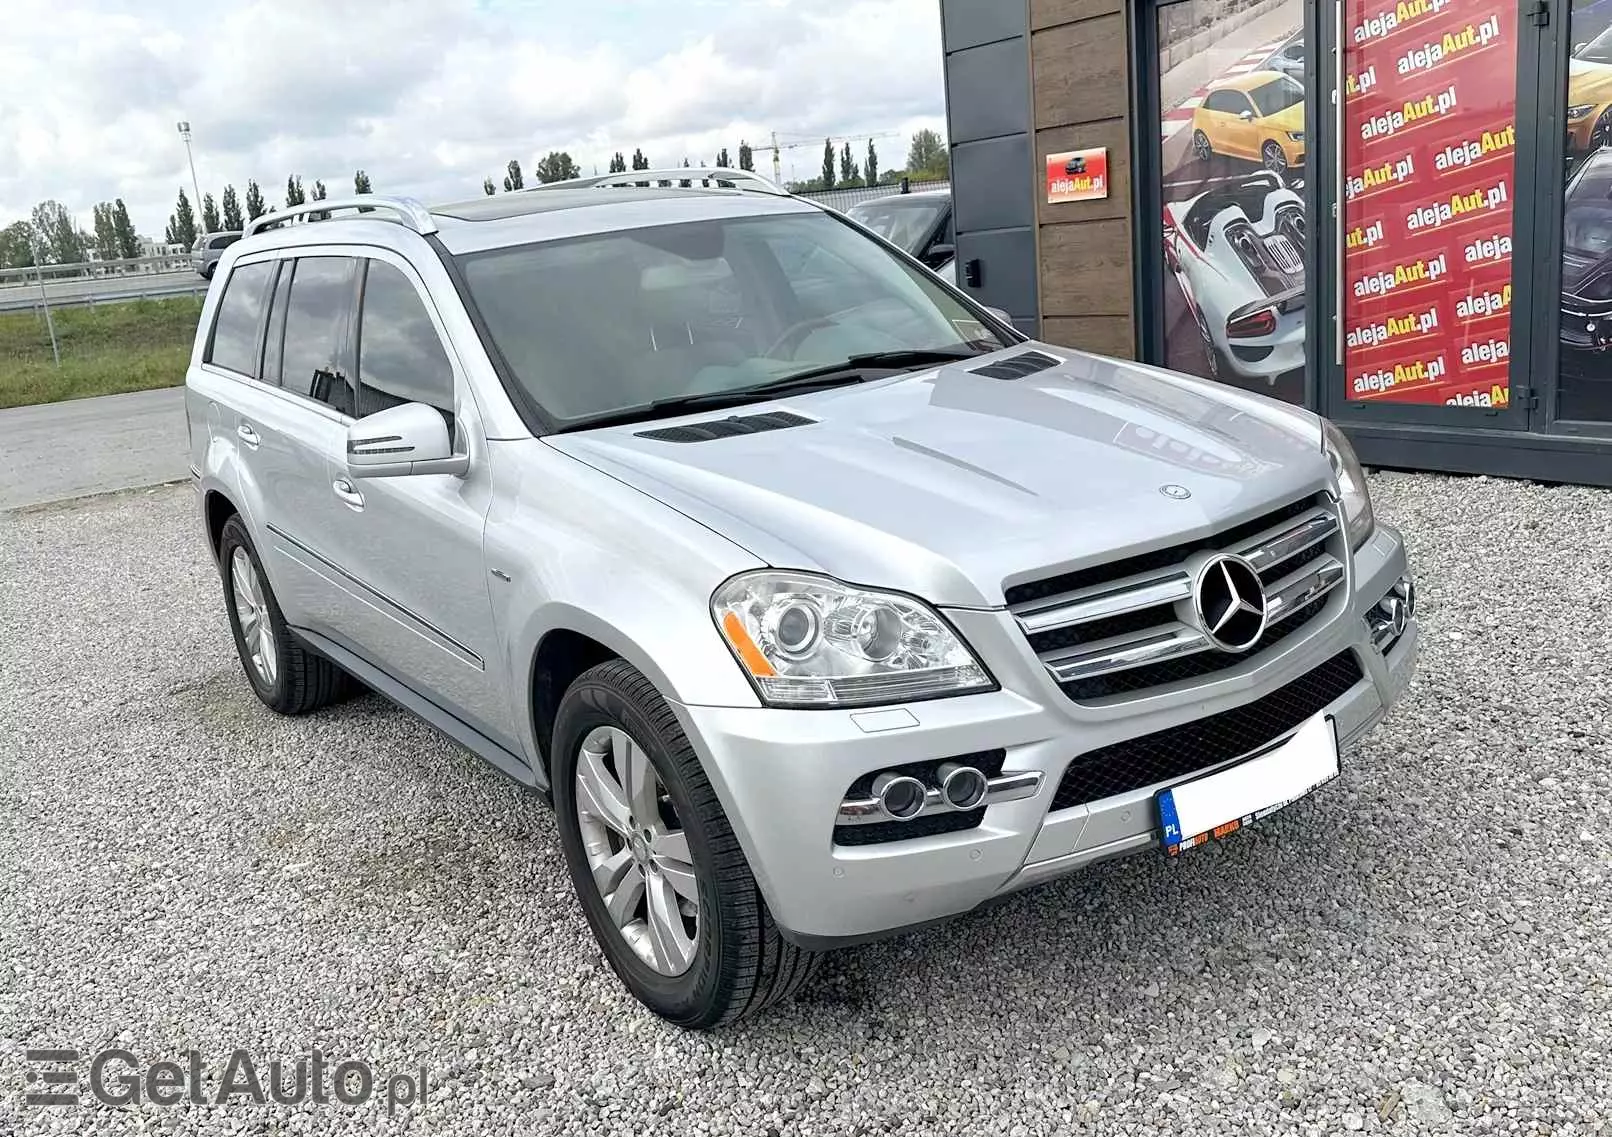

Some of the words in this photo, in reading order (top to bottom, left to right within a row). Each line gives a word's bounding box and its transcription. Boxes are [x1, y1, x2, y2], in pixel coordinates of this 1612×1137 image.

[1354, 0, 1451, 42] alejaAut.p
[1398, 15, 1500, 75] alejaAut.pl
[1361, 87, 1456, 140] alejaAut.pl
[1435, 125, 1515, 170] alejaAut
[1051, 175, 1103, 196] alejaAut.pl
[1407, 181, 1507, 230] alejaAut.pl
[1465, 235, 1512, 263] aleja
[1354, 254, 1446, 297] alejaAut.pl
[1347, 308, 1438, 347] alejaAut.pl
[1354, 357, 1445, 393] alejaAut.pl
[1165, 823, 1179, 838] PL
